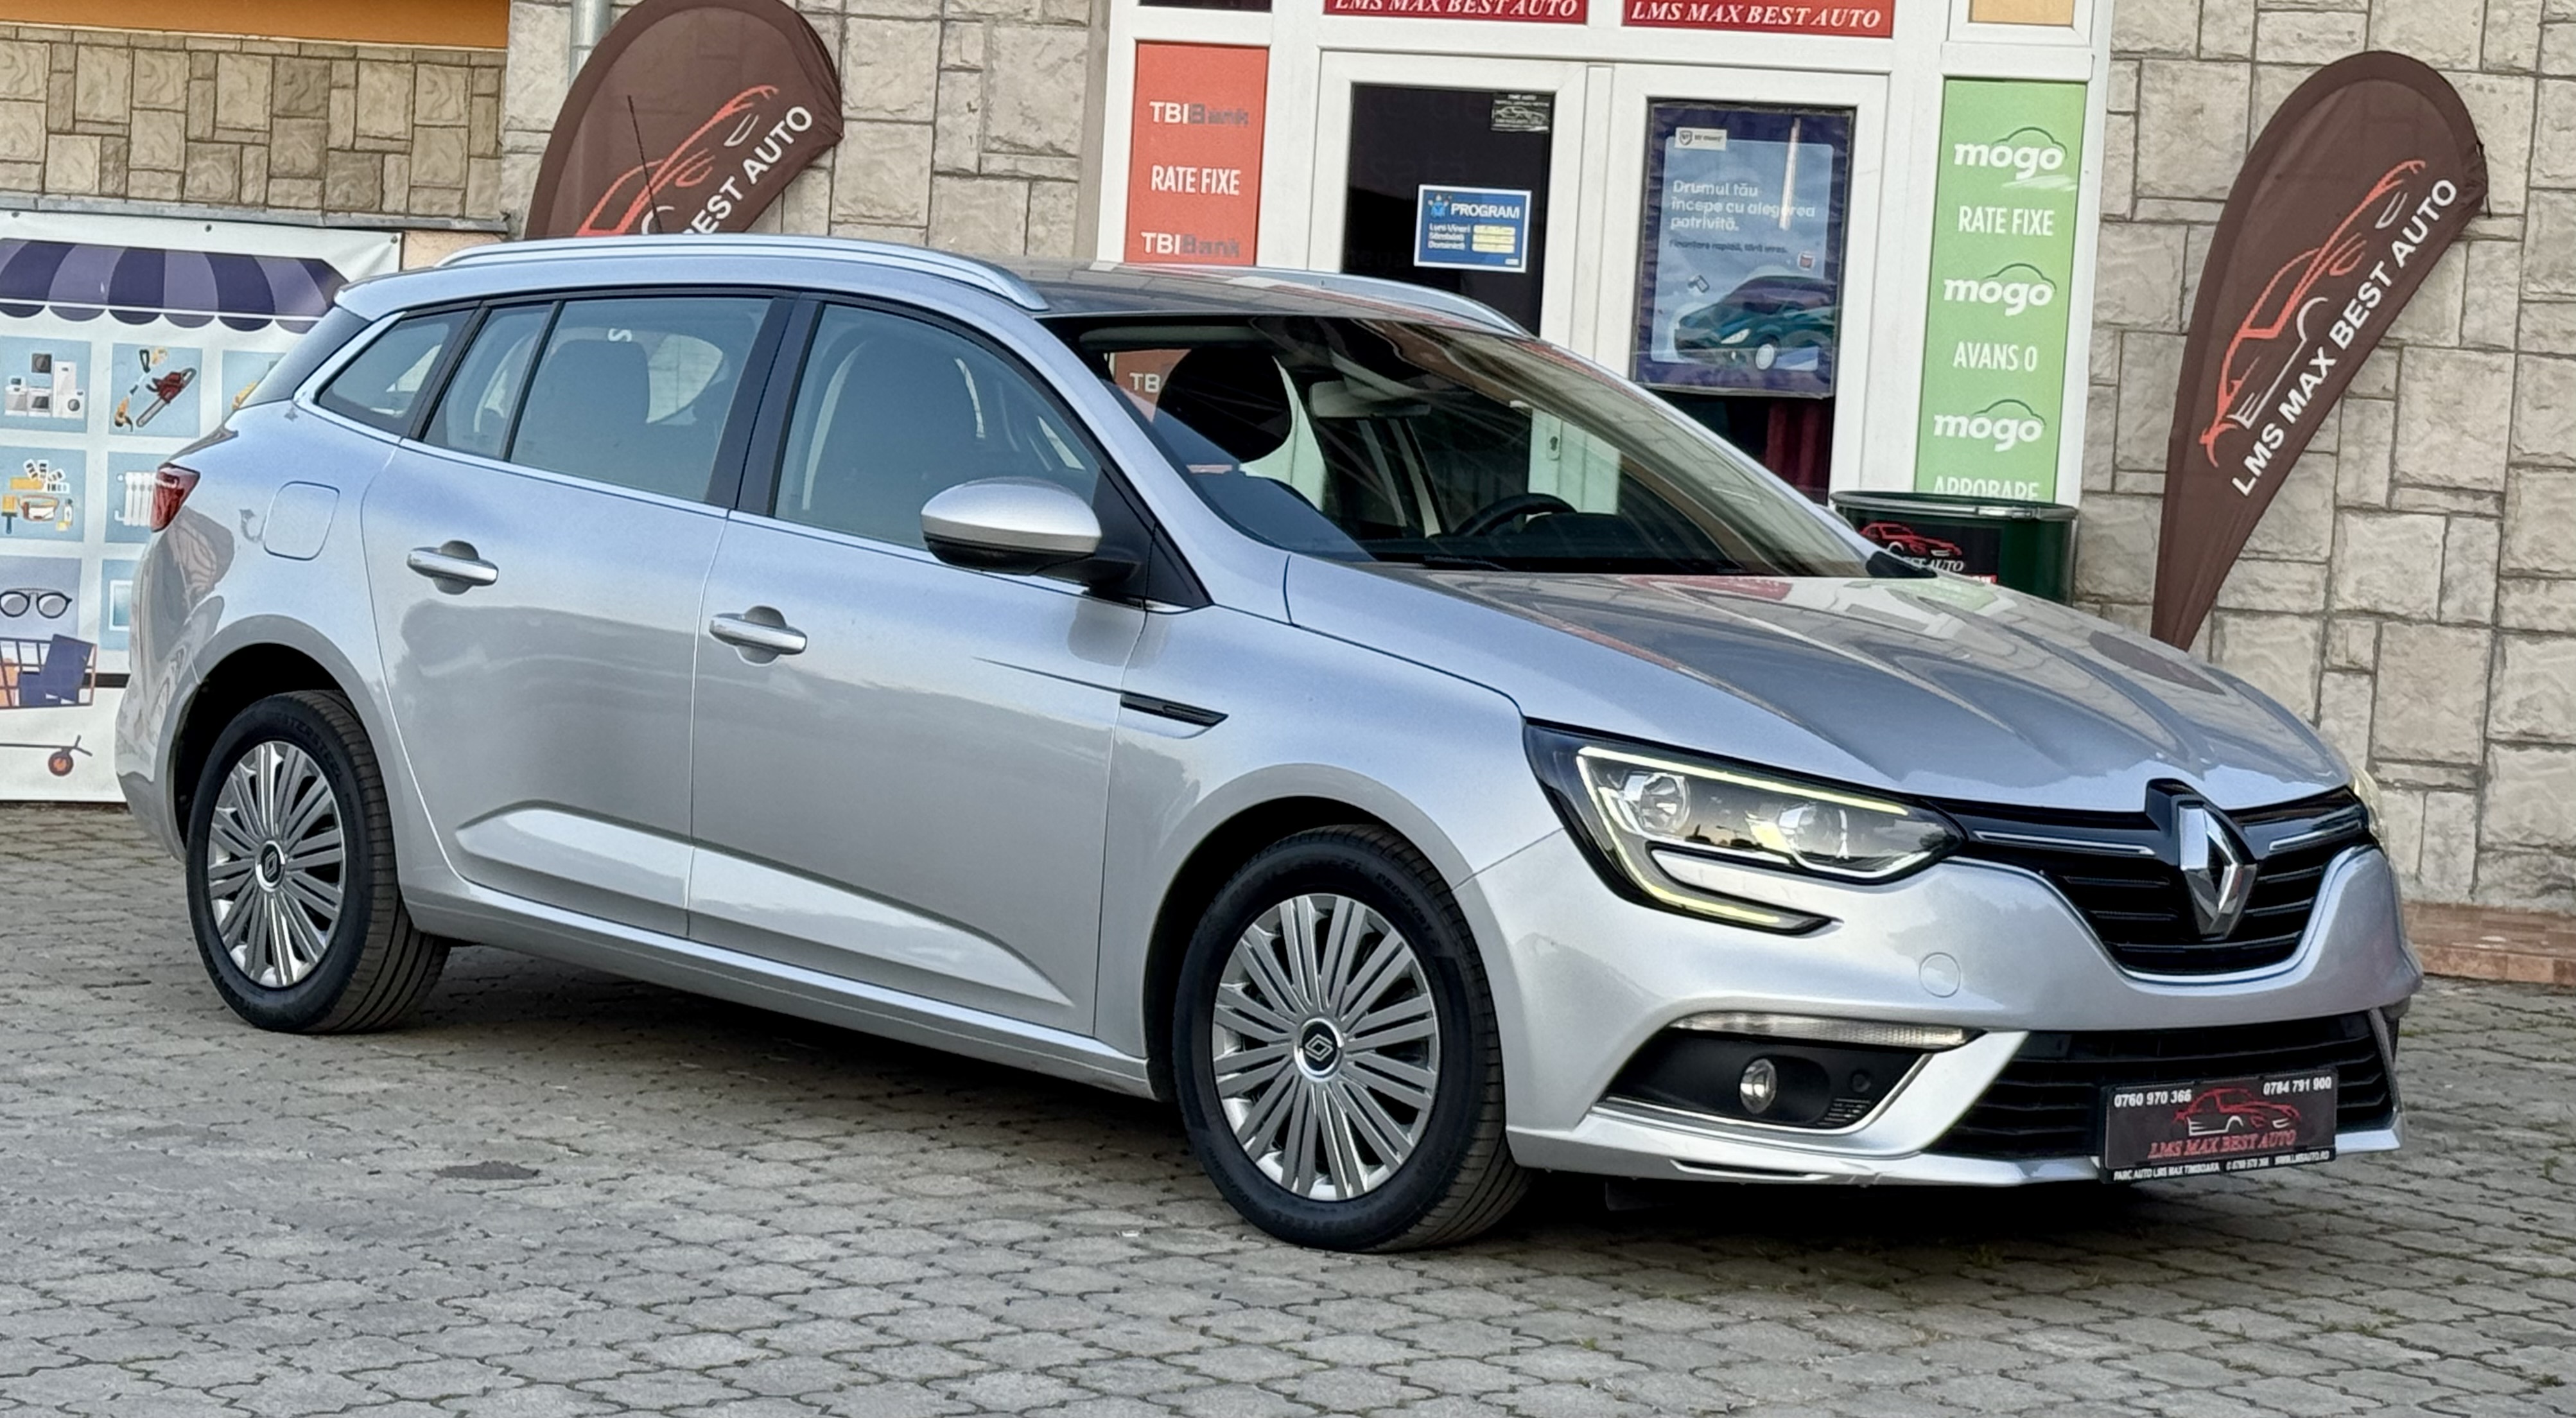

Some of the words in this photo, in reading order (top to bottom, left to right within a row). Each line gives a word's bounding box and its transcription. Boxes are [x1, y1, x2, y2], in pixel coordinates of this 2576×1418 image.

[1388, 0, 1441, 12] MAX
[1447, 0, 1510, 15] BEST
[1510, 0, 1578, 17] AUTO
[1631, 2, 1682, 21] LMS
[1685, 4, 1741, 24] MAX
[1746, 6, 1811, 26] BEST
[1810, 8, 1881, 28] AUTO
[683, 175, 743, 234] EST
[742, 106, 812, 185] AUTO
[1954, 143, 2063, 180] mogo
[1151, 165, 1197, 193] RATE
[1200, 168, 1241, 196] FIXE
[1673, 180, 1729, 195] Drumul
[1733, 182, 1758, 197] tău
[1450, 203, 1520, 219] PROGRAM
[1671, 196, 1723, 216] începe
[1726, 202, 1744, 214] cu
[1958, 206, 2008, 234] RATE
[2012, 209, 2055, 236] FIXE
[1670, 217, 1740, 232] potrivită.
[1944, 278, 2053, 317] mogo
[2231, 423, 2284, 496] LMS
[2278, 346, 2338, 424] MAX
[2329, 260, 2392, 350] BEST
[2391, 179, 2457, 268] AUTO
[1953, 341, 2019, 371] AVANS
[1933, 414, 2042, 452] mogo
[2114, 1093, 2144, 1108] 0760
[2146, 1091, 2168, 1105] 970
[2263, 1080, 2290, 1096] 0784
[2292, 1079, 2310, 1093] 791
[2313, 1076, 2332, 1090] 900
[2147, 1142, 2183, 1160] LMS
[2184, 1137, 2220, 1156] MAX
[2220, 1134, 2259, 1153] BEST
[2258, 1130, 2297, 1149] AUTO
